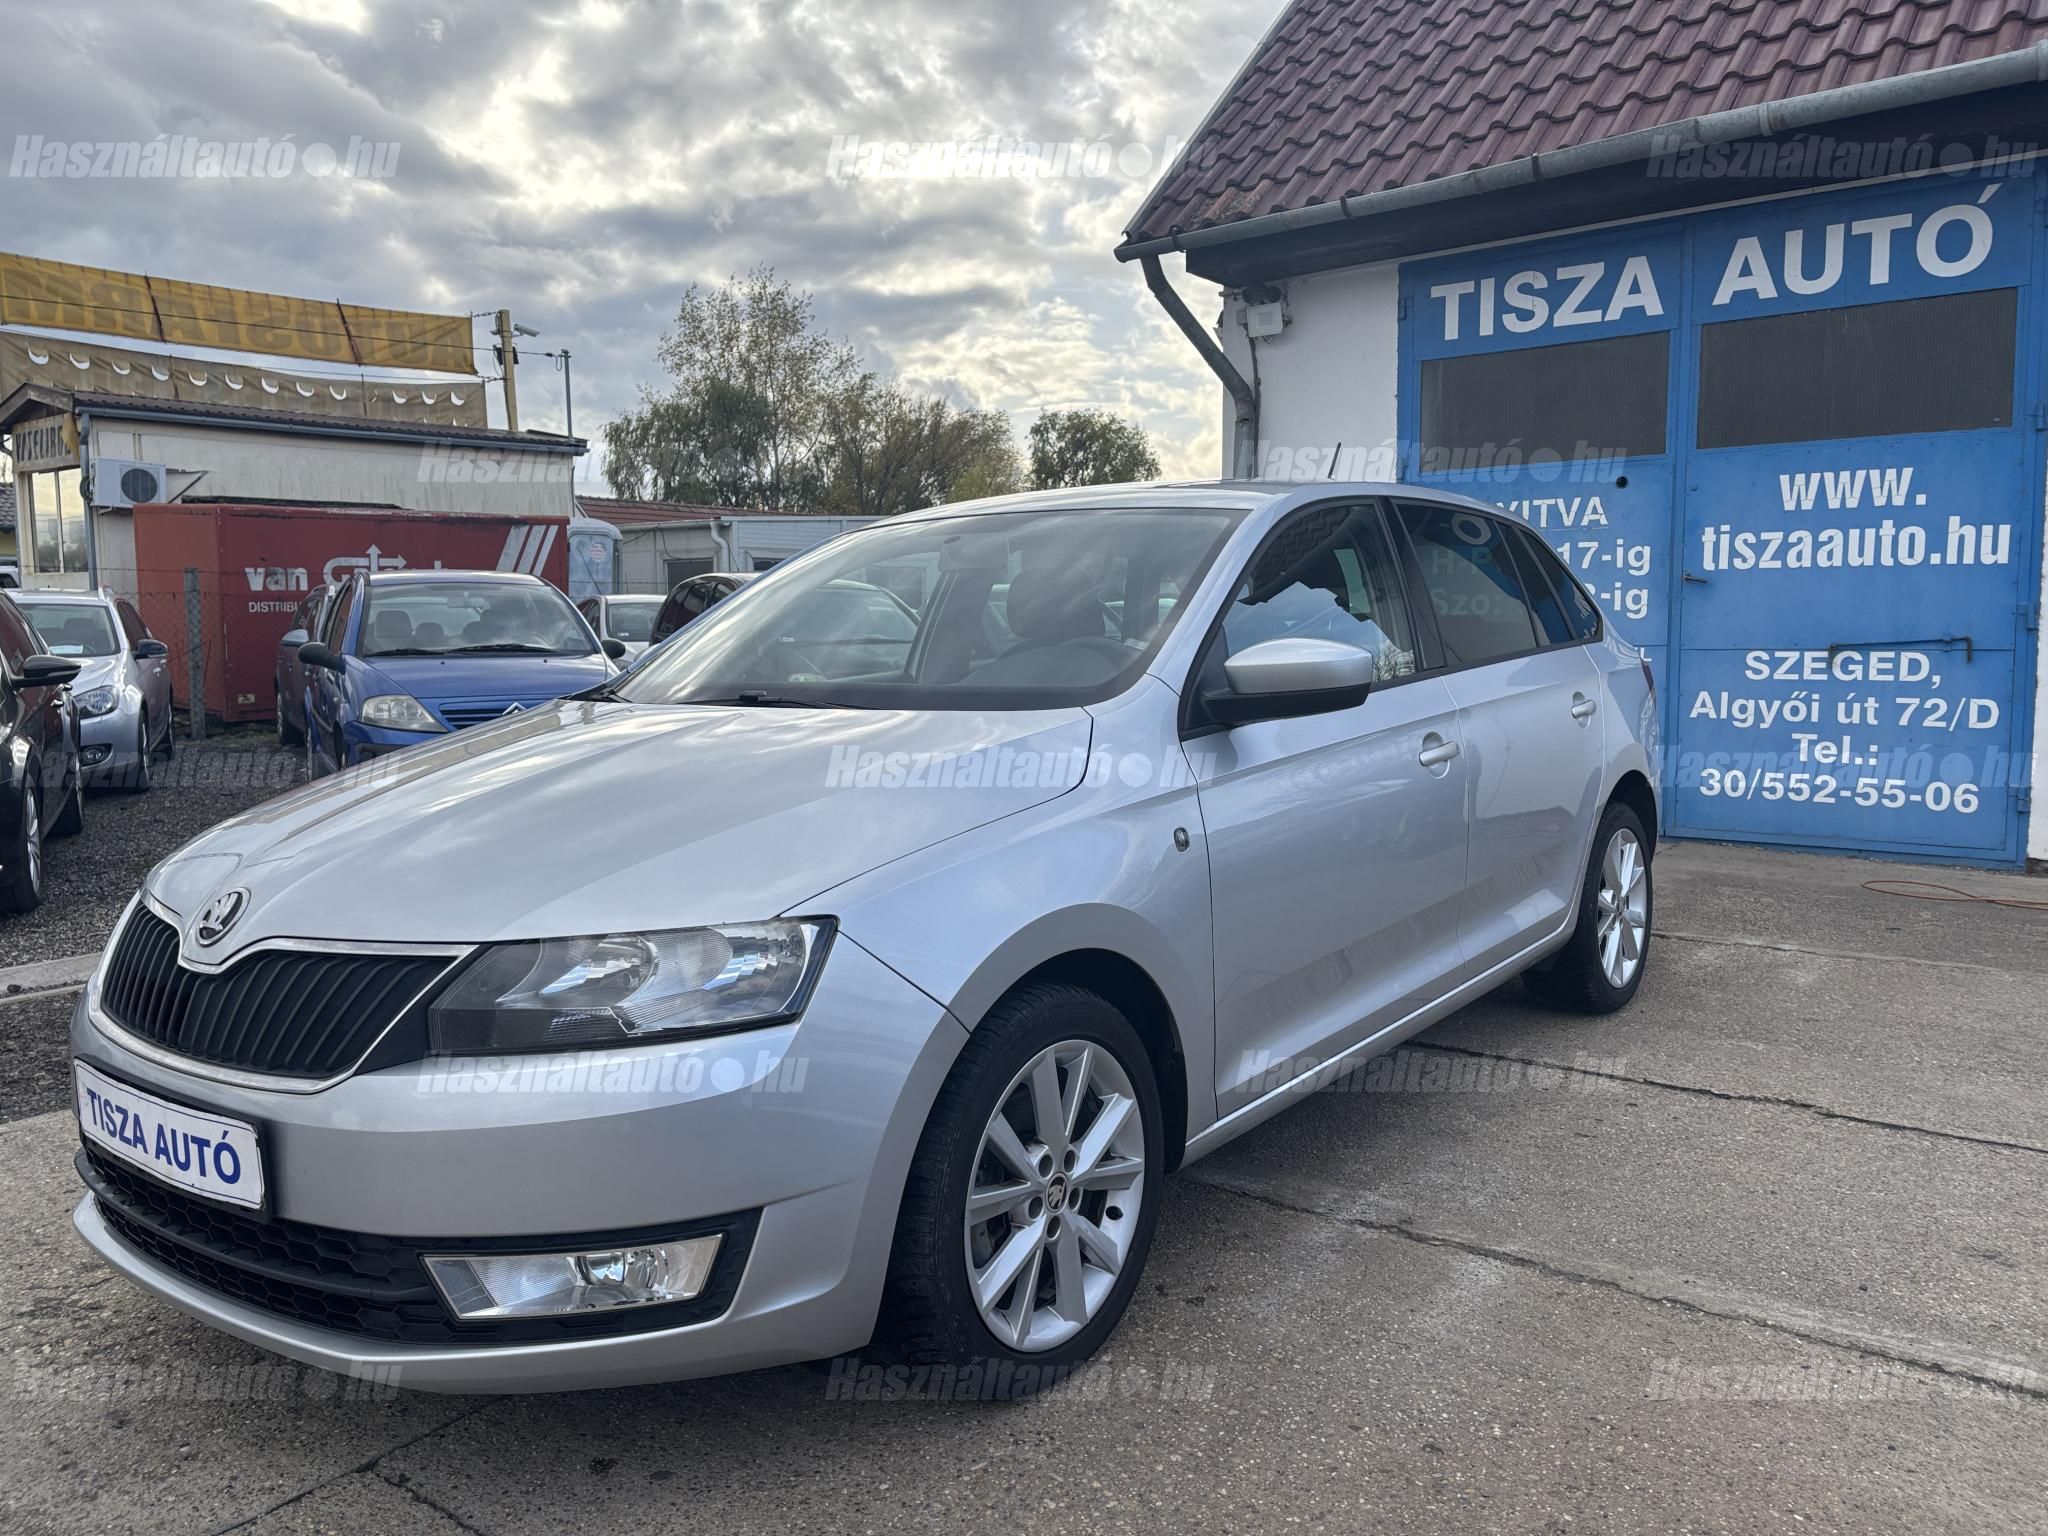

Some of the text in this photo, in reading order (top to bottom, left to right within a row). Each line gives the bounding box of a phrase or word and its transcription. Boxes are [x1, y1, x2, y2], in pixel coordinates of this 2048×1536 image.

[1430, 183, 2003, 341] TISZA AUTÓ
[1780, 467, 1927, 512] www.
[1701, 515, 2011, 572] tiszaauto.hu
[244, 567, 309, 592] van
[1745, 651, 1942, 687] SZEGED,
[1690, 690, 2000, 731] Algyői út 72/D
[1792, 733, 1879, 766] Tel.:
[1699, 768, 1980, 814] 30/552-55-06
[86, 1088, 242, 1185] TISZA AUTÓ
